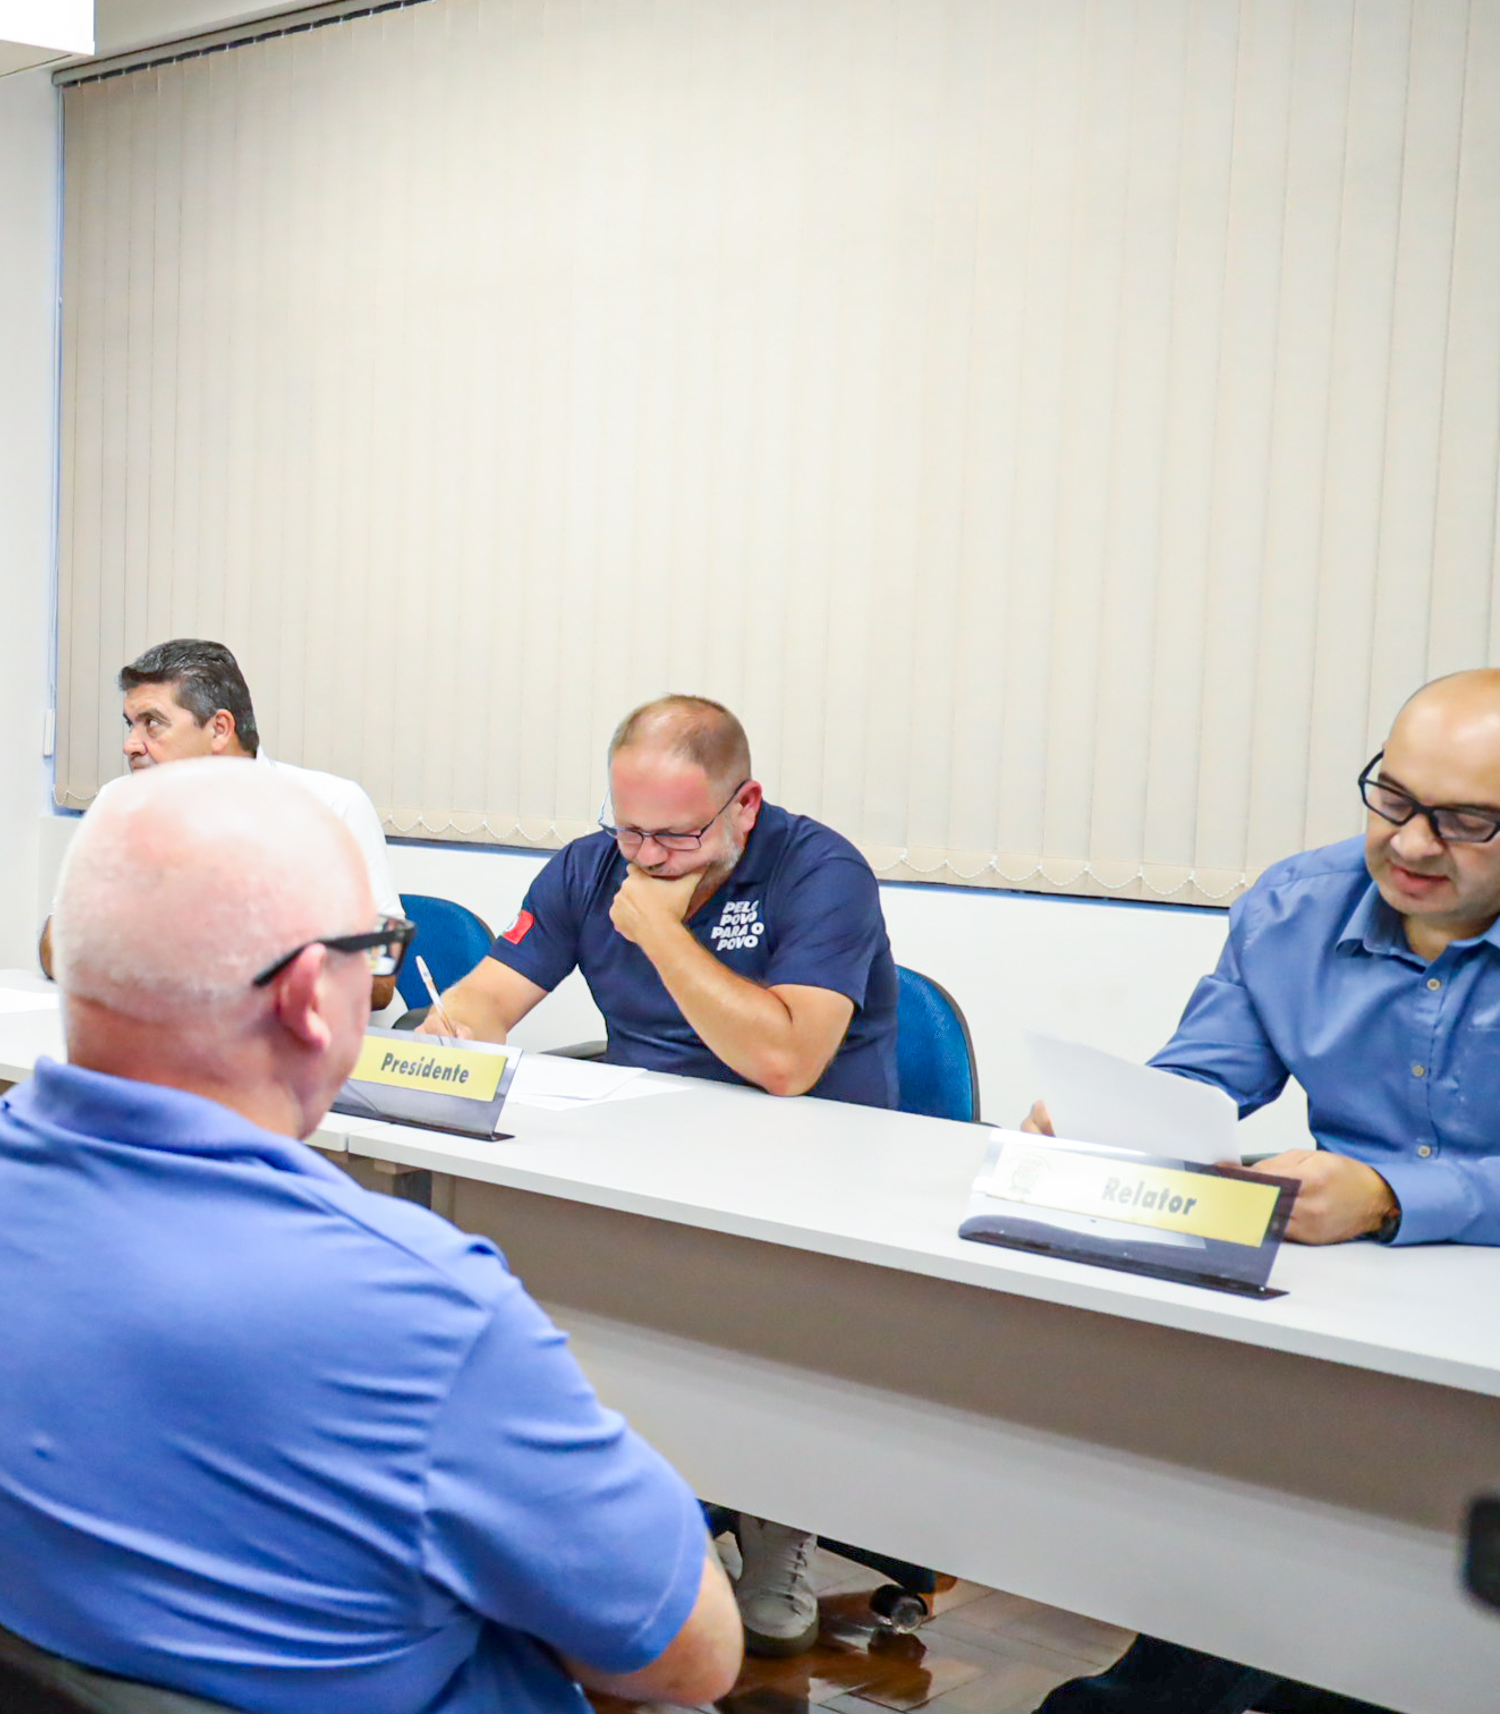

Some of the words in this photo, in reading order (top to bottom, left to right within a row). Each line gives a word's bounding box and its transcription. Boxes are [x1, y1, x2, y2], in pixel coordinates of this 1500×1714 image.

[719, 911, 758, 927] POVO
[710, 924, 749, 939] PARA
[750, 921, 765, 936] O
[716, 934, 759, 951] POVO
[380, 1052, 469, 1084] Presidente
[1101, 1176, 1197, 1216] Relator
